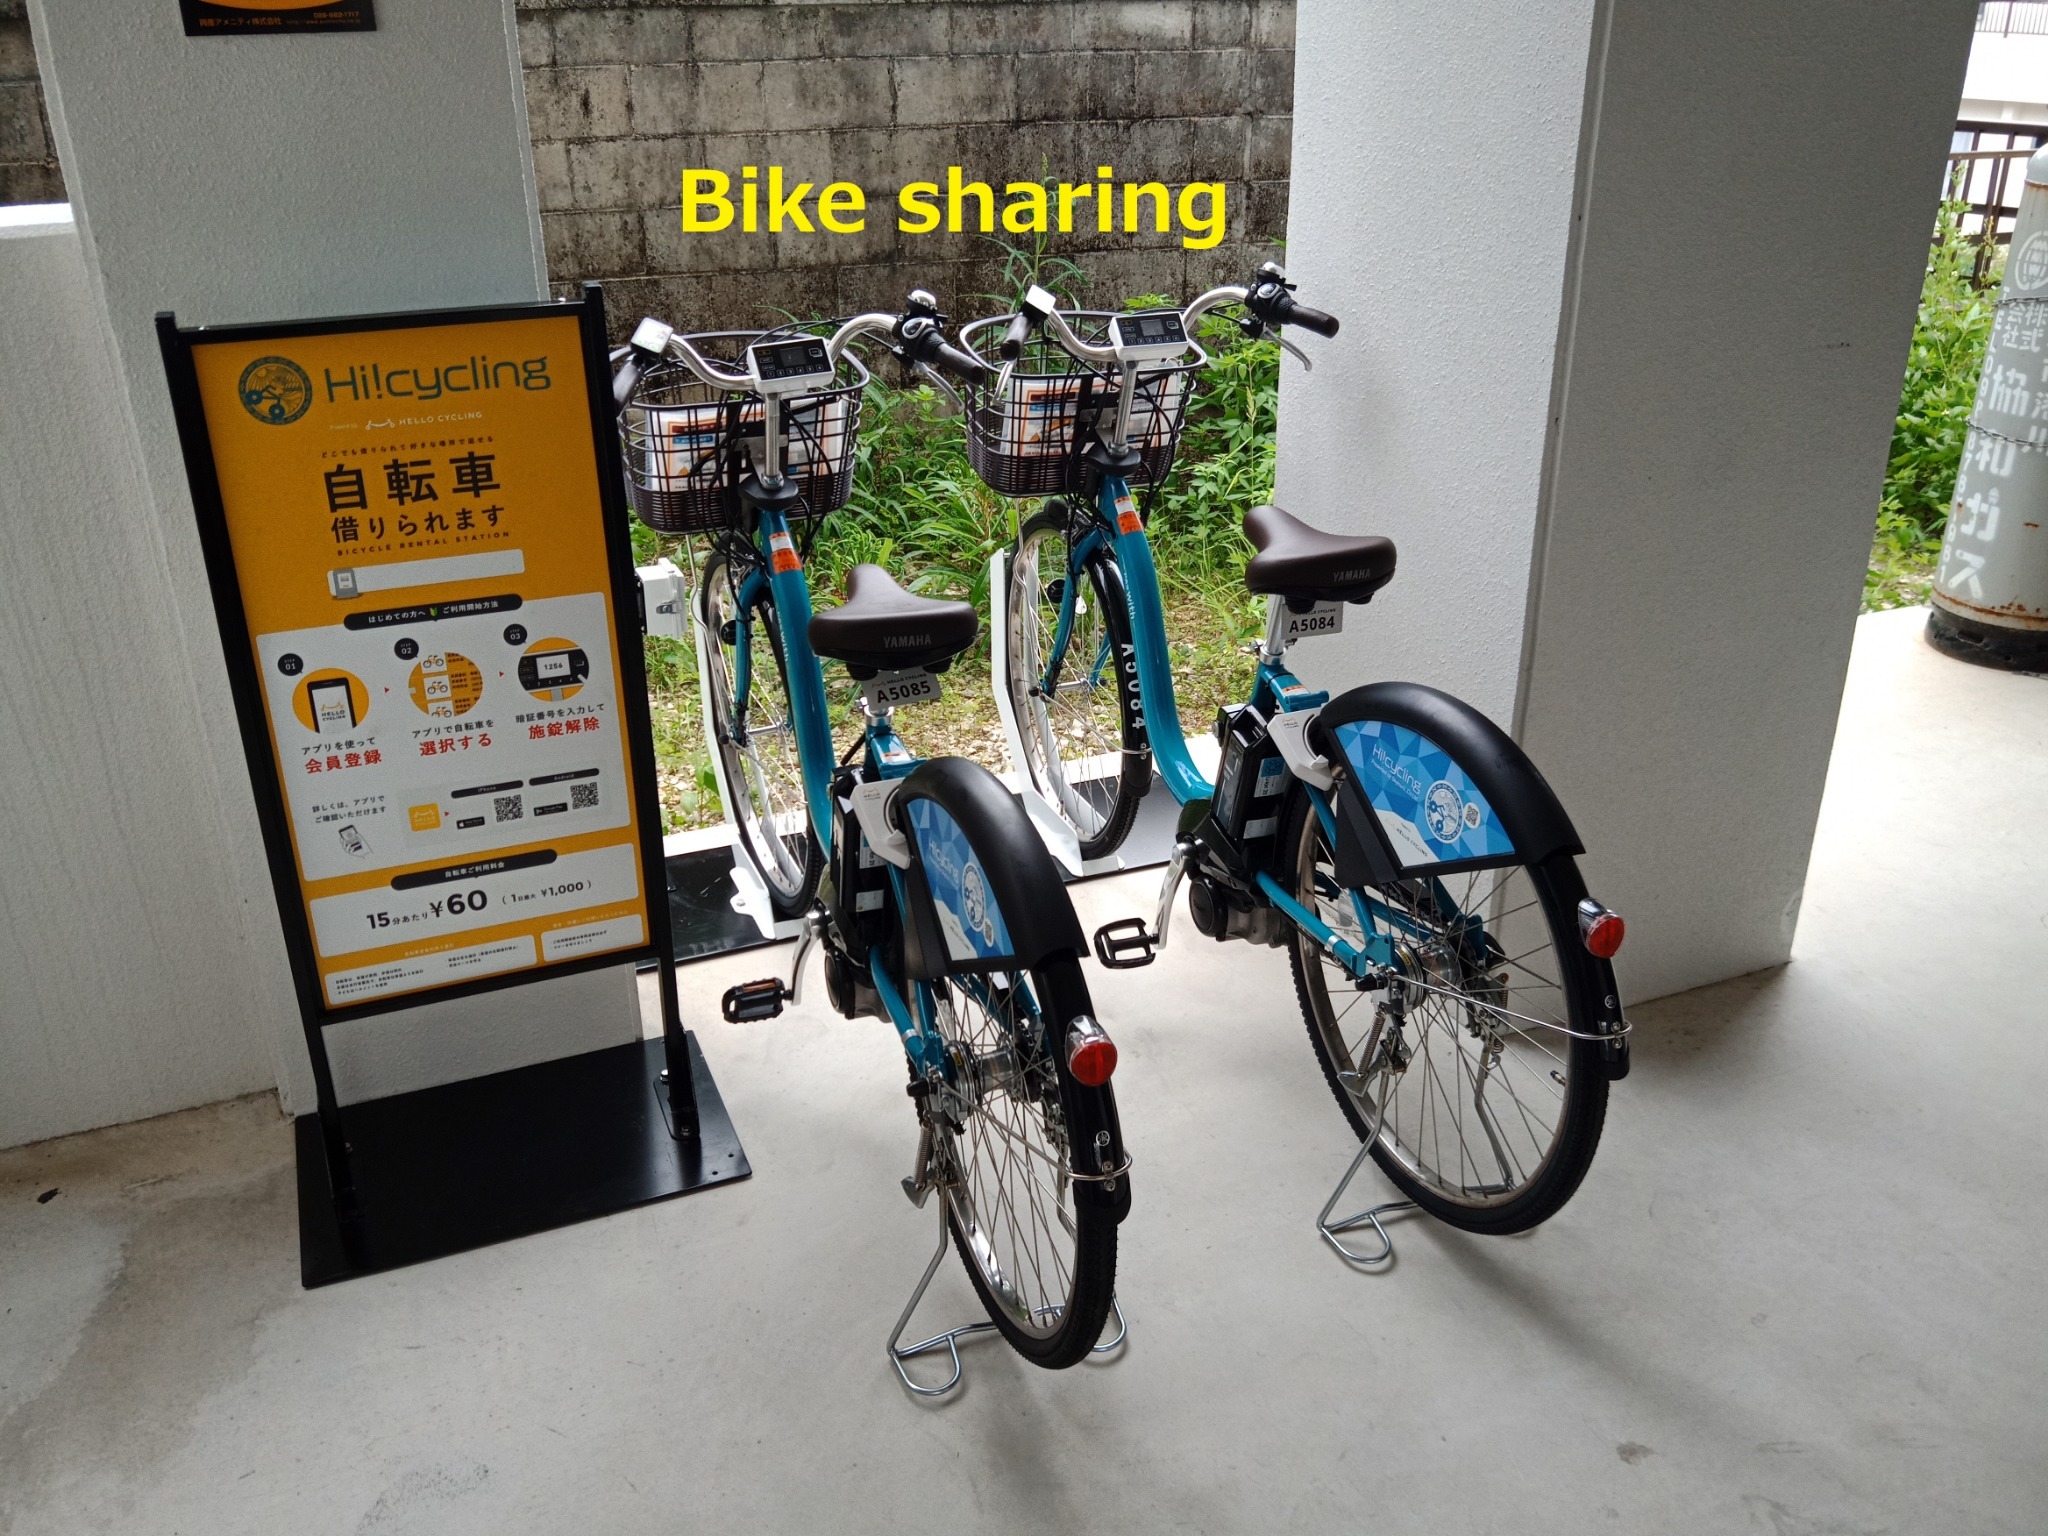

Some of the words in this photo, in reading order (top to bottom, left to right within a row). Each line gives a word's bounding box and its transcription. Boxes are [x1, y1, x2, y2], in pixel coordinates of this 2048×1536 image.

[324, 355, 551, 403] Hi!cycling
[399, 416, 434, 426] HELLO
[438, 412, 483, 423] CYCLING
[323, 451, 501, 513] 自転車
[331, 504, 506, 544] 借りられます
[337, 544, 392, 556] BICYCLE
[400, 538, 448, 549] RENTAL
[456, 531, 510, 542] STATION
[1333, 568, 1371, 582] YAMAHA
[368, 609, 426, 624] はじめての方へ
[442, 600, 499, 615] ご利用開始方法
[1288, 615, 1335, 633] A5084
[510, 632, 521, 641] 03
[883, 634, 932, 648] YAMAHA
[401, 646, 413, 655] 02
[285, 662, 297, 671] 01
[877, 680, 931, 703] A5085
[1121, 643, 1146, 730] A5084
[321, 709, 345, 718] HELLO
[515, 703, 606, 723] 暗証番号を入力して
[412, 719, 495, 738] アプリで自転車を
[527, 717, 601, 740] 施錠解除
[301, 736, 376, 756] アプリを使って
[419, 733, 493, 757] 選択する
[305, 749, 383, 774] 会員登録
[445, 860, 505, 878] 自転車ご利用料金
[541, 881, 584, 898] ¥1,000
